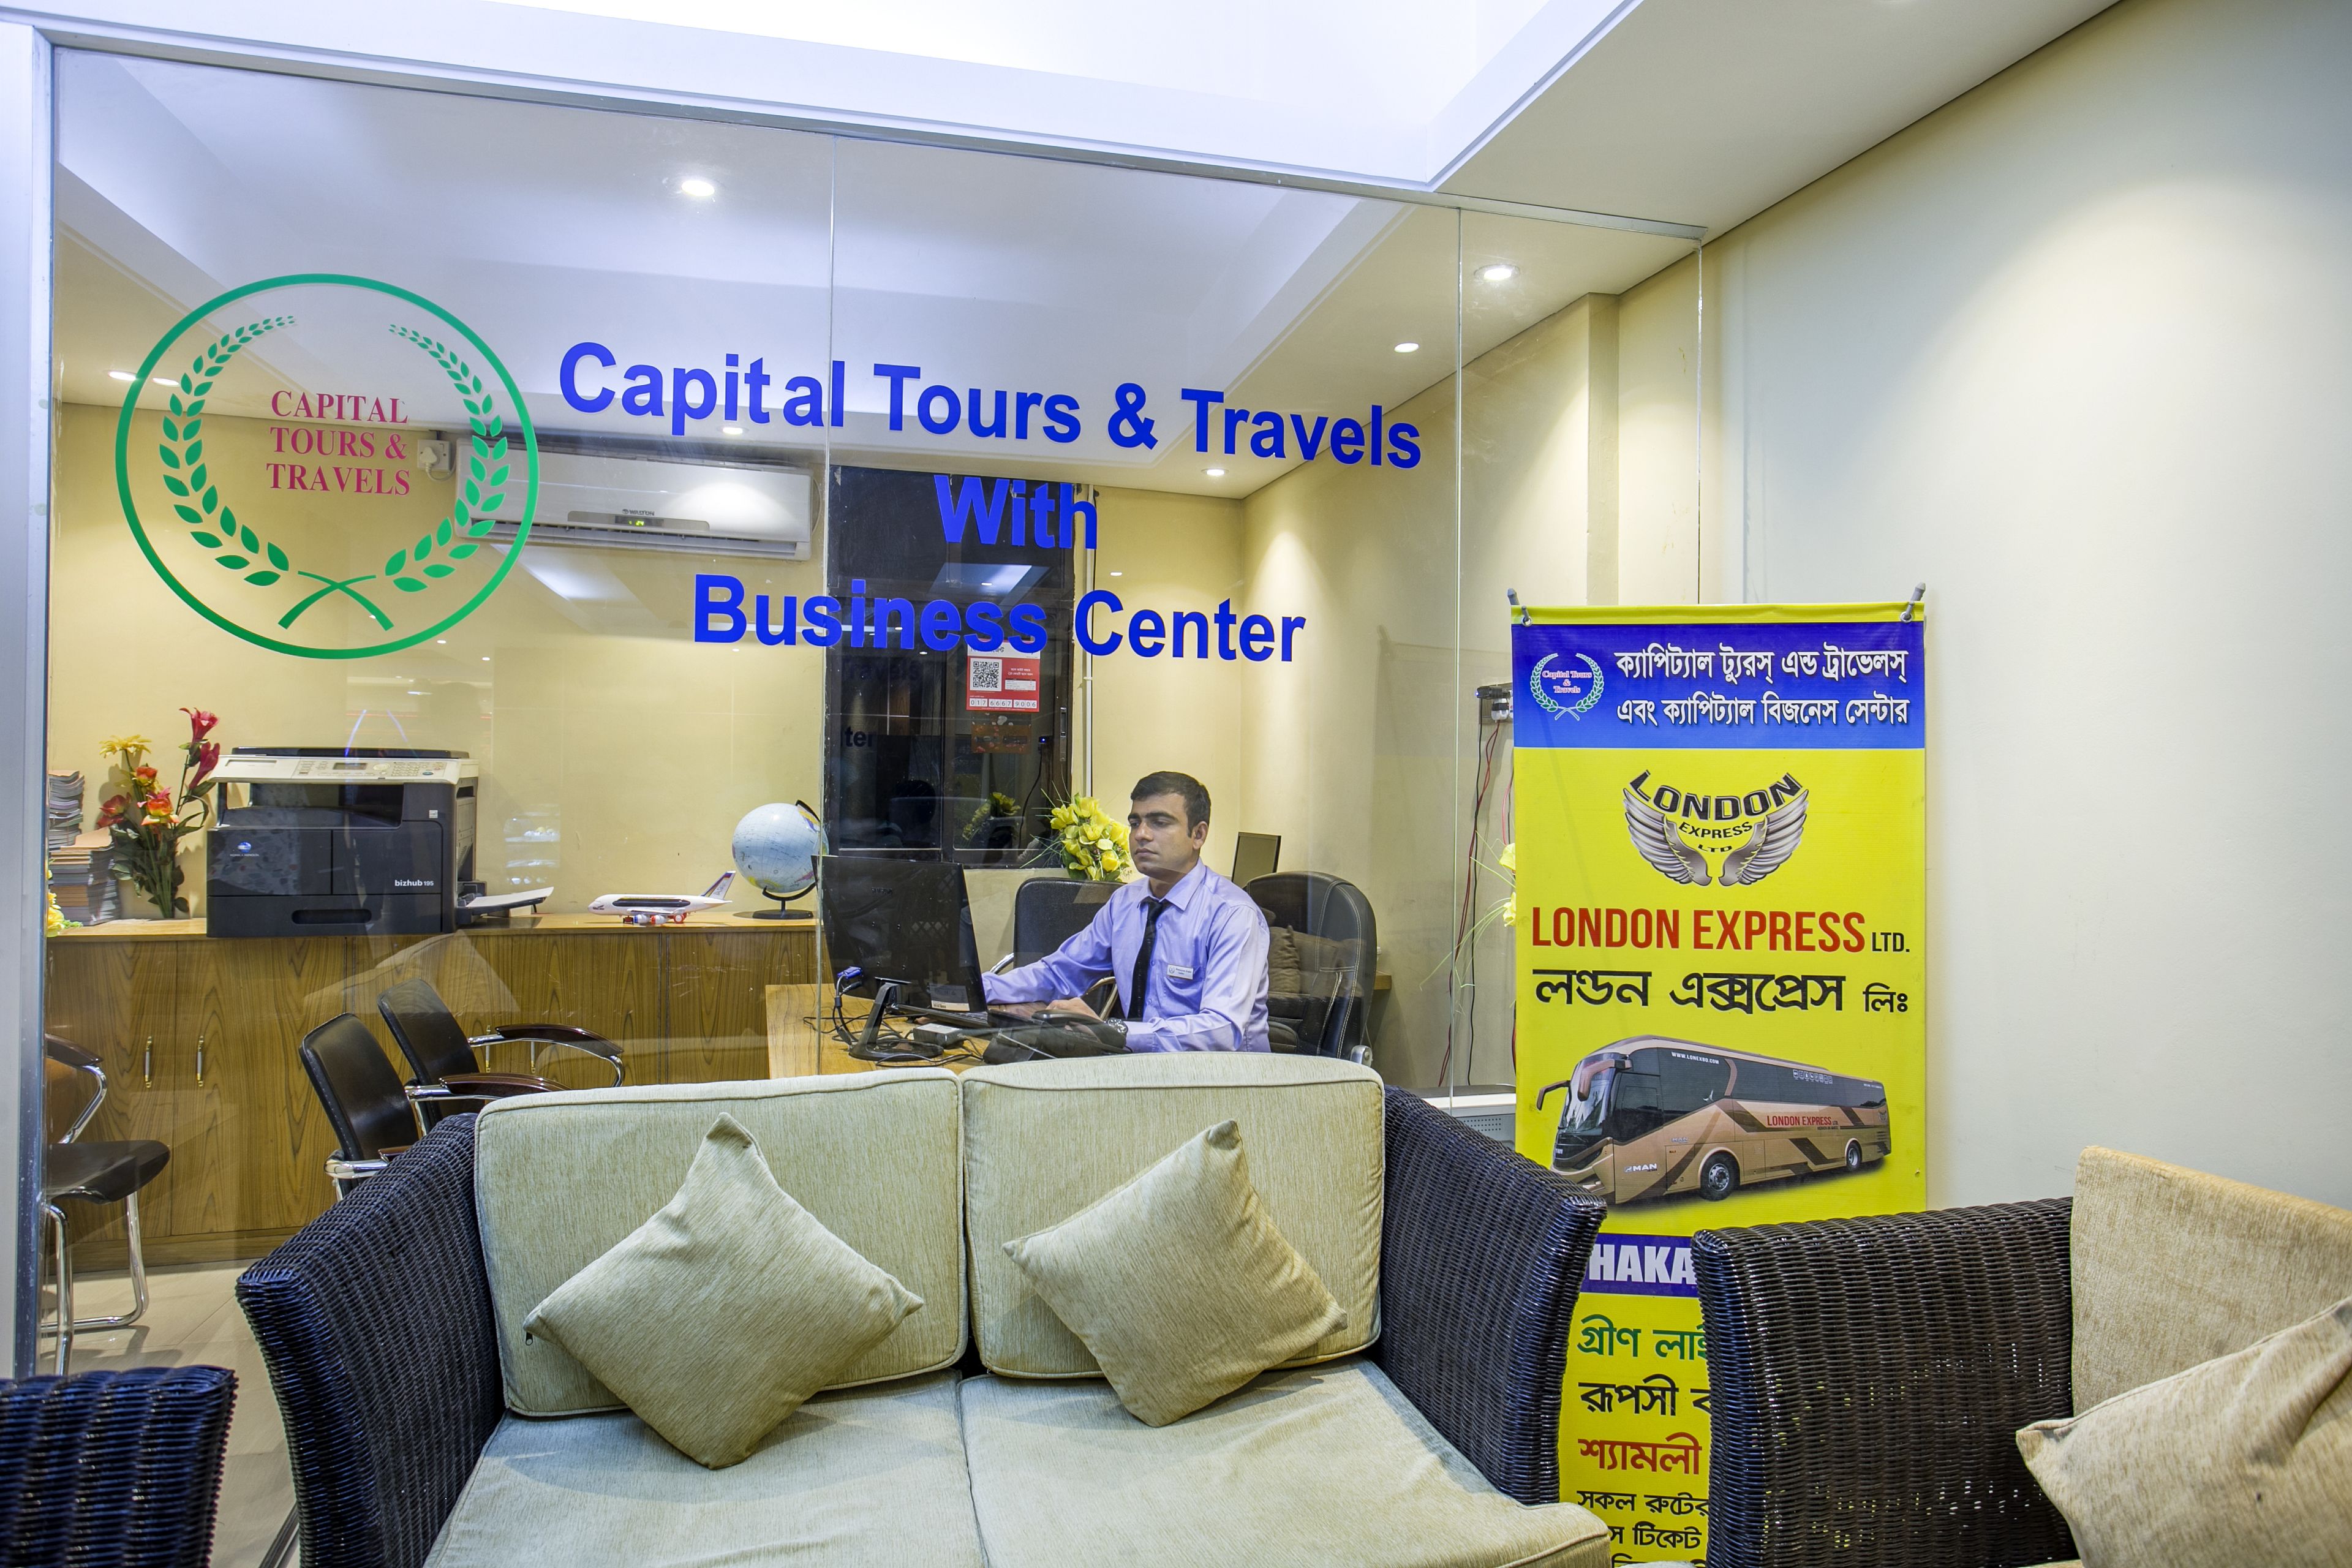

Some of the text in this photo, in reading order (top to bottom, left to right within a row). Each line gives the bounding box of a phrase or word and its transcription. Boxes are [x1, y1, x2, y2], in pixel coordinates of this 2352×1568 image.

[271, 390, 409, 424] CAPITAL
[559, 342, 1422, 469] Capital Tours & Travels
[270, 427, 407, 461] TOURS &
[266, 463, 410, 496] TRAVELS
[933, 475, 1097, 549] With
[694, 573, 1306, 662] Business Center
[1542, 671, 1570, 679] Capital
[1613, 642, 1716, 679] ক্যাপিট্যাল
[1719, 642, 1776, 685] ট্যুরস্
[1822, 641, 1910, 684] ট্রাভেলস্
[1617, 690, 1911, 727] এবং ক্যাপিট্যাল বিজনেস সেন্টার
[841, 726, 878, 747] ter
[1629, 769, 1803, 821] LONDON
[1678, 821, 1753, 839] EXPRESS
[1698, 843, 1733, 853] LTD
[1532, 907, 1910, 952] LONDON EXPRESS LTD.
[1668, 972, 1846, 1014] এক্সপ্রেস
[1862, 982, 1908, 1012] লিঃ
[1766, 1115, 1800, 1126] LONDON
[1802, 1116, 1831, 1126] EXPRESS
[1578, 1373, 1679, 1416] রূপসী
[1578, 1431, 1703, 1475] শ্যামলী
[1576, 1490, 1637, 1511] সকল
[1632, 1521, 1702, 1548] টিকেট
